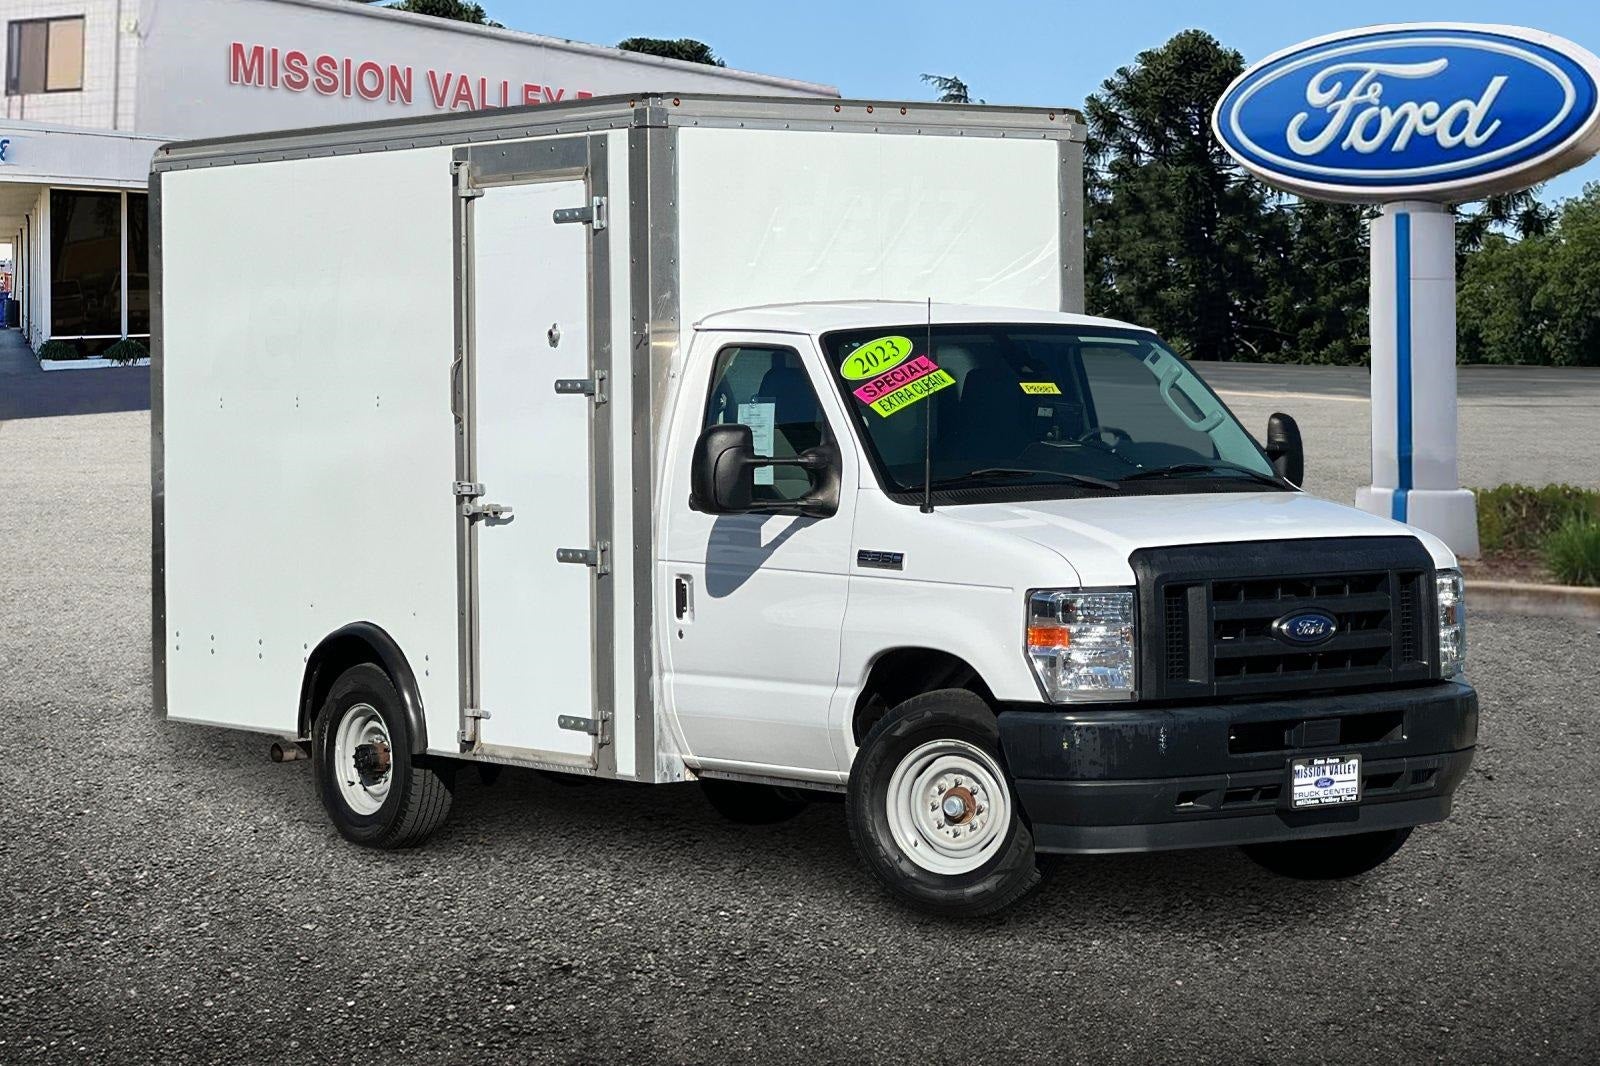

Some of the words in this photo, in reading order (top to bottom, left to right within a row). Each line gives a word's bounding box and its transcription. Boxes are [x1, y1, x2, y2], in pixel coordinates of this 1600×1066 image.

[230, 41, 413, 104] MISSION
[1286, 57, 1509, 156] Ford
[854, 340, 900, 375] 2023
[862, 359, 929, 398] SPECIAL
[877, 387, 914, 412] EXTRA
[911, 372, 946, 395] CLEAN
[1297, 620, 1325, 635] Ford
[1294, 766, 1327, 779] MISSION
[1329, 763, 1357, 776] VALLEY
[1316, 779, 1332, 787] Ford
[1294, 790, 1320, 798] TRUCK
[1323, 787, 1357, 796] CENTER
